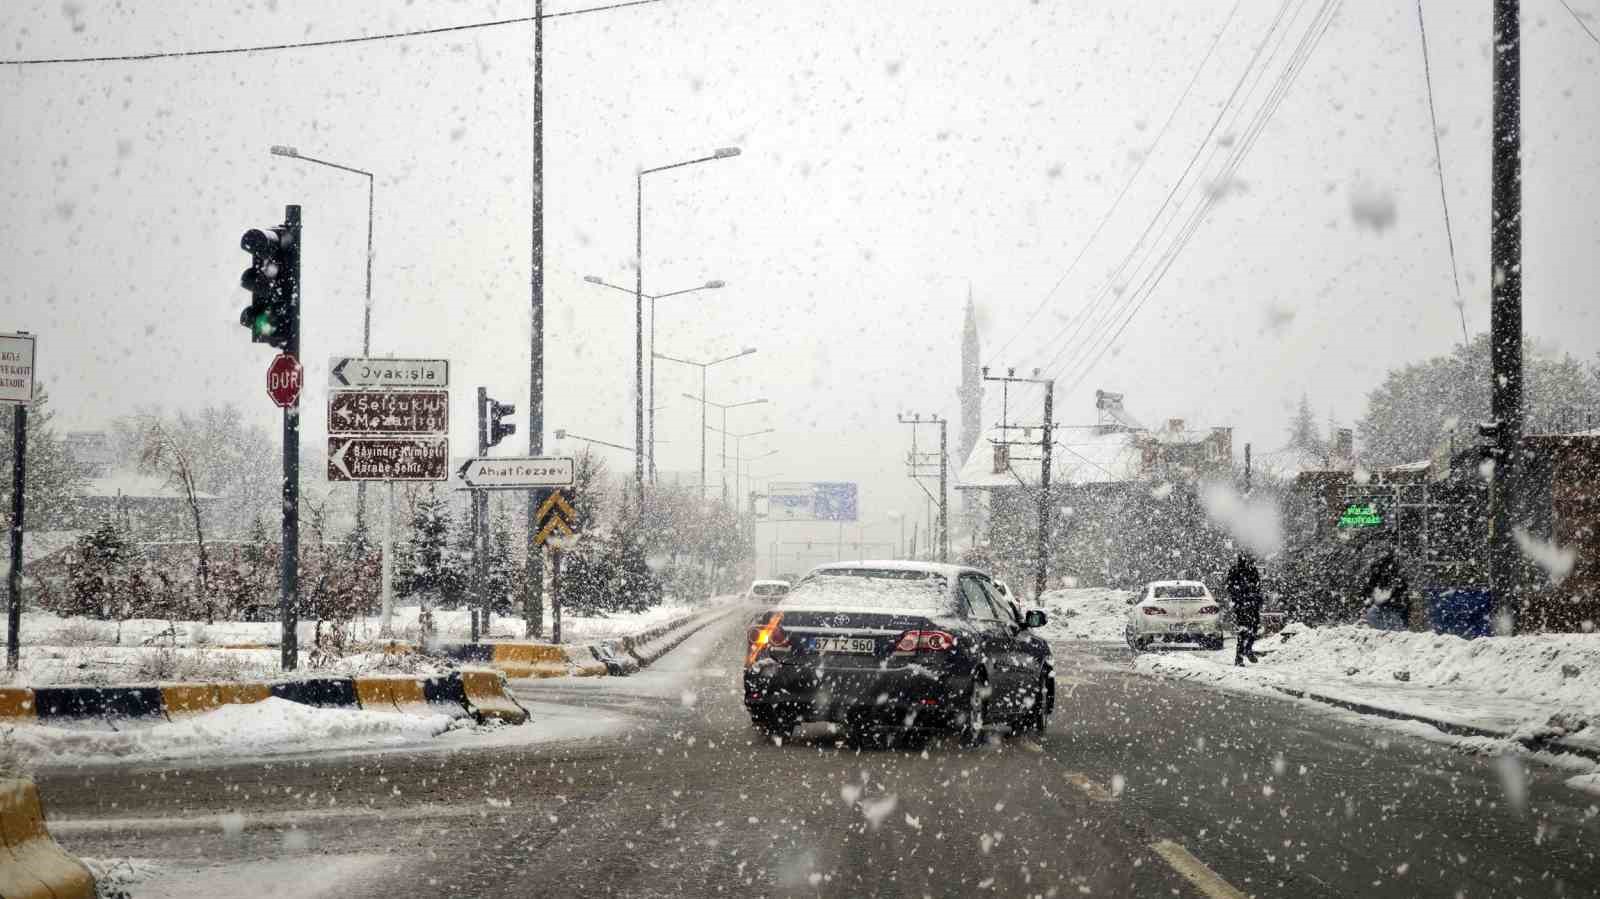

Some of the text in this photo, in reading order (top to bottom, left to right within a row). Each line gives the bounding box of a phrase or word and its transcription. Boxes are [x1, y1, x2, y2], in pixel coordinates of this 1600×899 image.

[360, 366, 435, 379] Ovakışla
[271, 370, 300, 390] DUR
[394, 462, 421, 474] Şehir
[852, 639, 873, 651] 960
